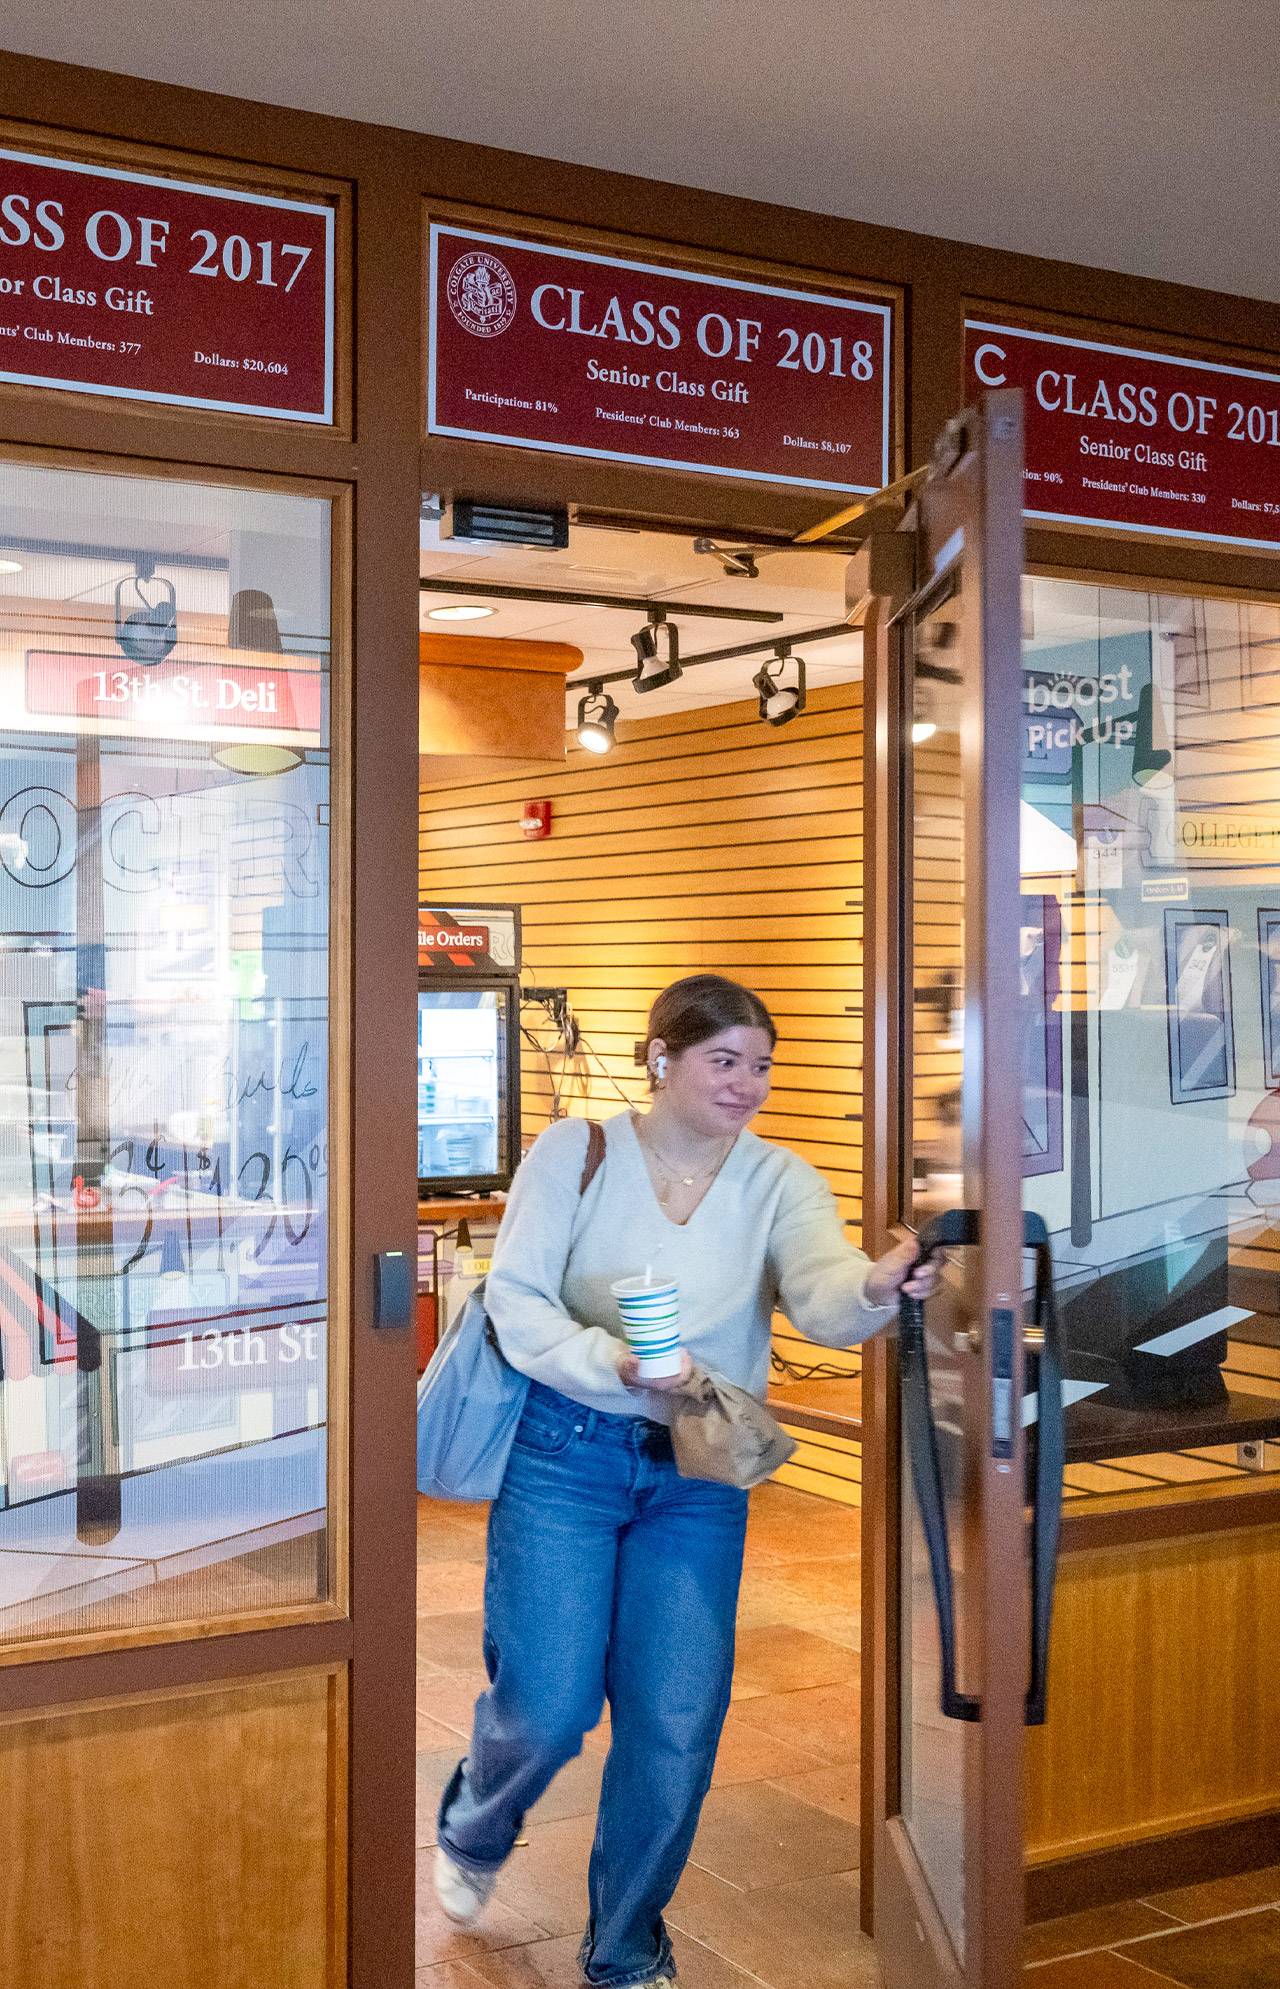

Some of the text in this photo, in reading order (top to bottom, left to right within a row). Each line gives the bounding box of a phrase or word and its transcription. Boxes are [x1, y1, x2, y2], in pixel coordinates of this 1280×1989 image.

[0, 194, 312, 293] SS OF 2017
[33, 275, 97, 307] Class
[105, 287, 154, 315] Gift
[24, 327, 54, 342] Club
[57, 332, 115, 351] Members:
[119, 341, 141, 355] 377
[530, 283, 874, 381] CLASS OF 2018
[194, 351, 288, 376] Dollars: $20,604
[586, 359, 749, 404] Senior Class Gift
[464, 389, 558, 413] Participation: 81%
[1036, 370, 1280, 446] CLASS OF 201
[595, 408, 740, 439] Presidents' Club Members: 363
[783, 434, 852, 455] Dollars: $8,107
[1079, 435, 1208, 472] Senior Class Gift
[1044, 472, 1063, 484] 90%
[1082, 477, 1206, 504] Presidents' Club Members: 330
[1231, 498, 1261, 512] Dollars:
[93, 671, 160, 705] 13th
[216, 679, 277, 713] Deli
[1028, 664, 1134, 714] boost
[1028, 718, 1086, 752] Pick
[1092, 715, 1134, 750] Up
[436, 930, 483, 947] Orders
[177, 1322, 318, 1371] 13th St
